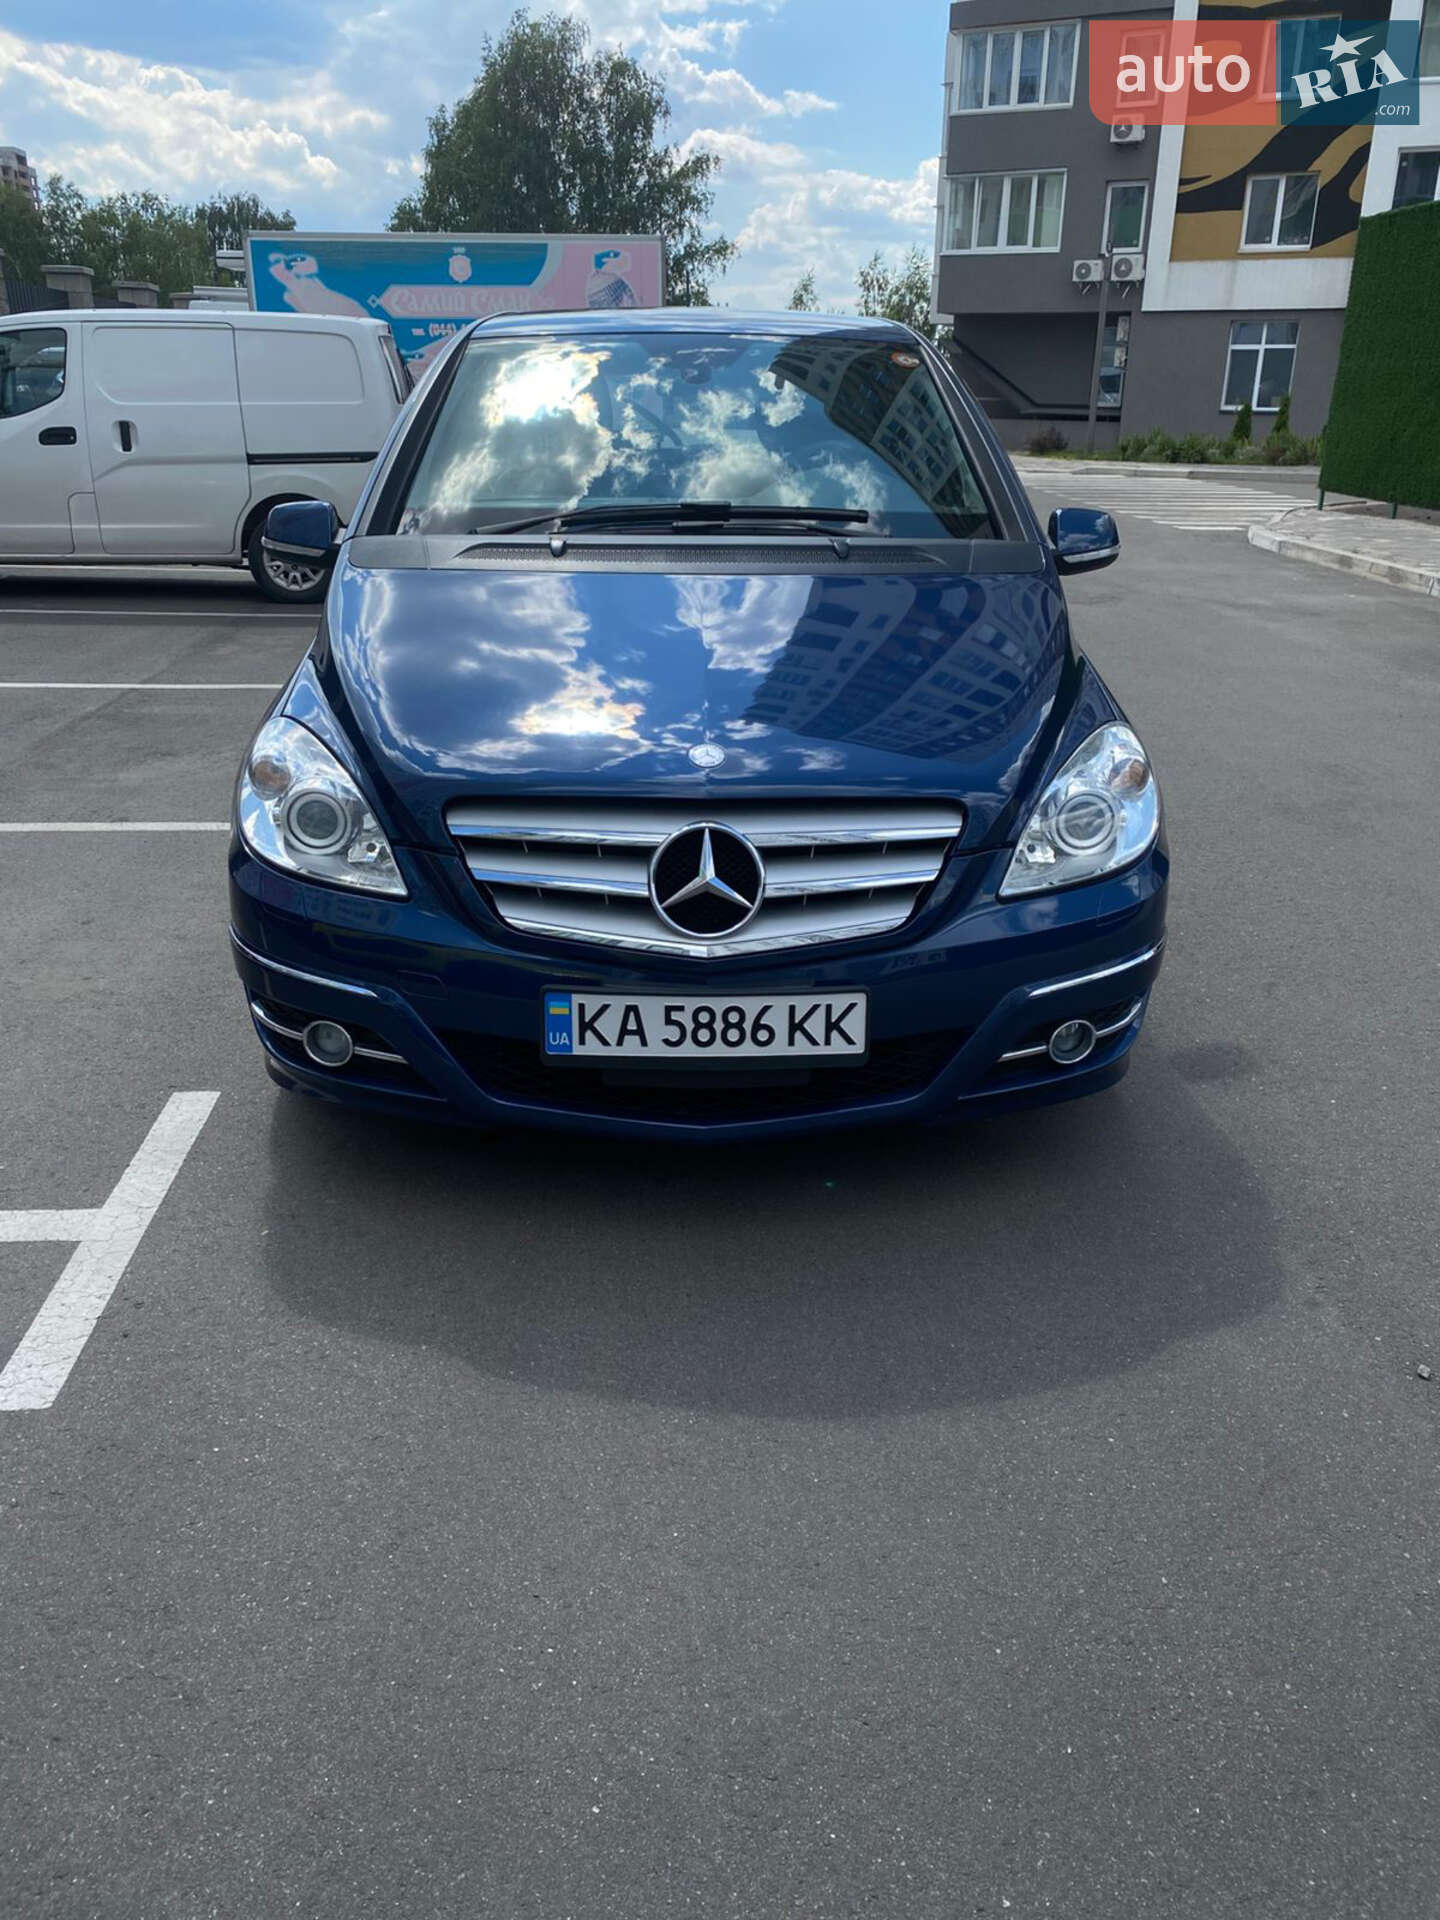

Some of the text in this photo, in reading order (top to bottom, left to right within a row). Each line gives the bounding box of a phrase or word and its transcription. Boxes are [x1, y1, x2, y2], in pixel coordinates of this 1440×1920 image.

[549, 1031, 570, 1046] UA
[577, 1002, 859, 1048] KA 5886 KK
